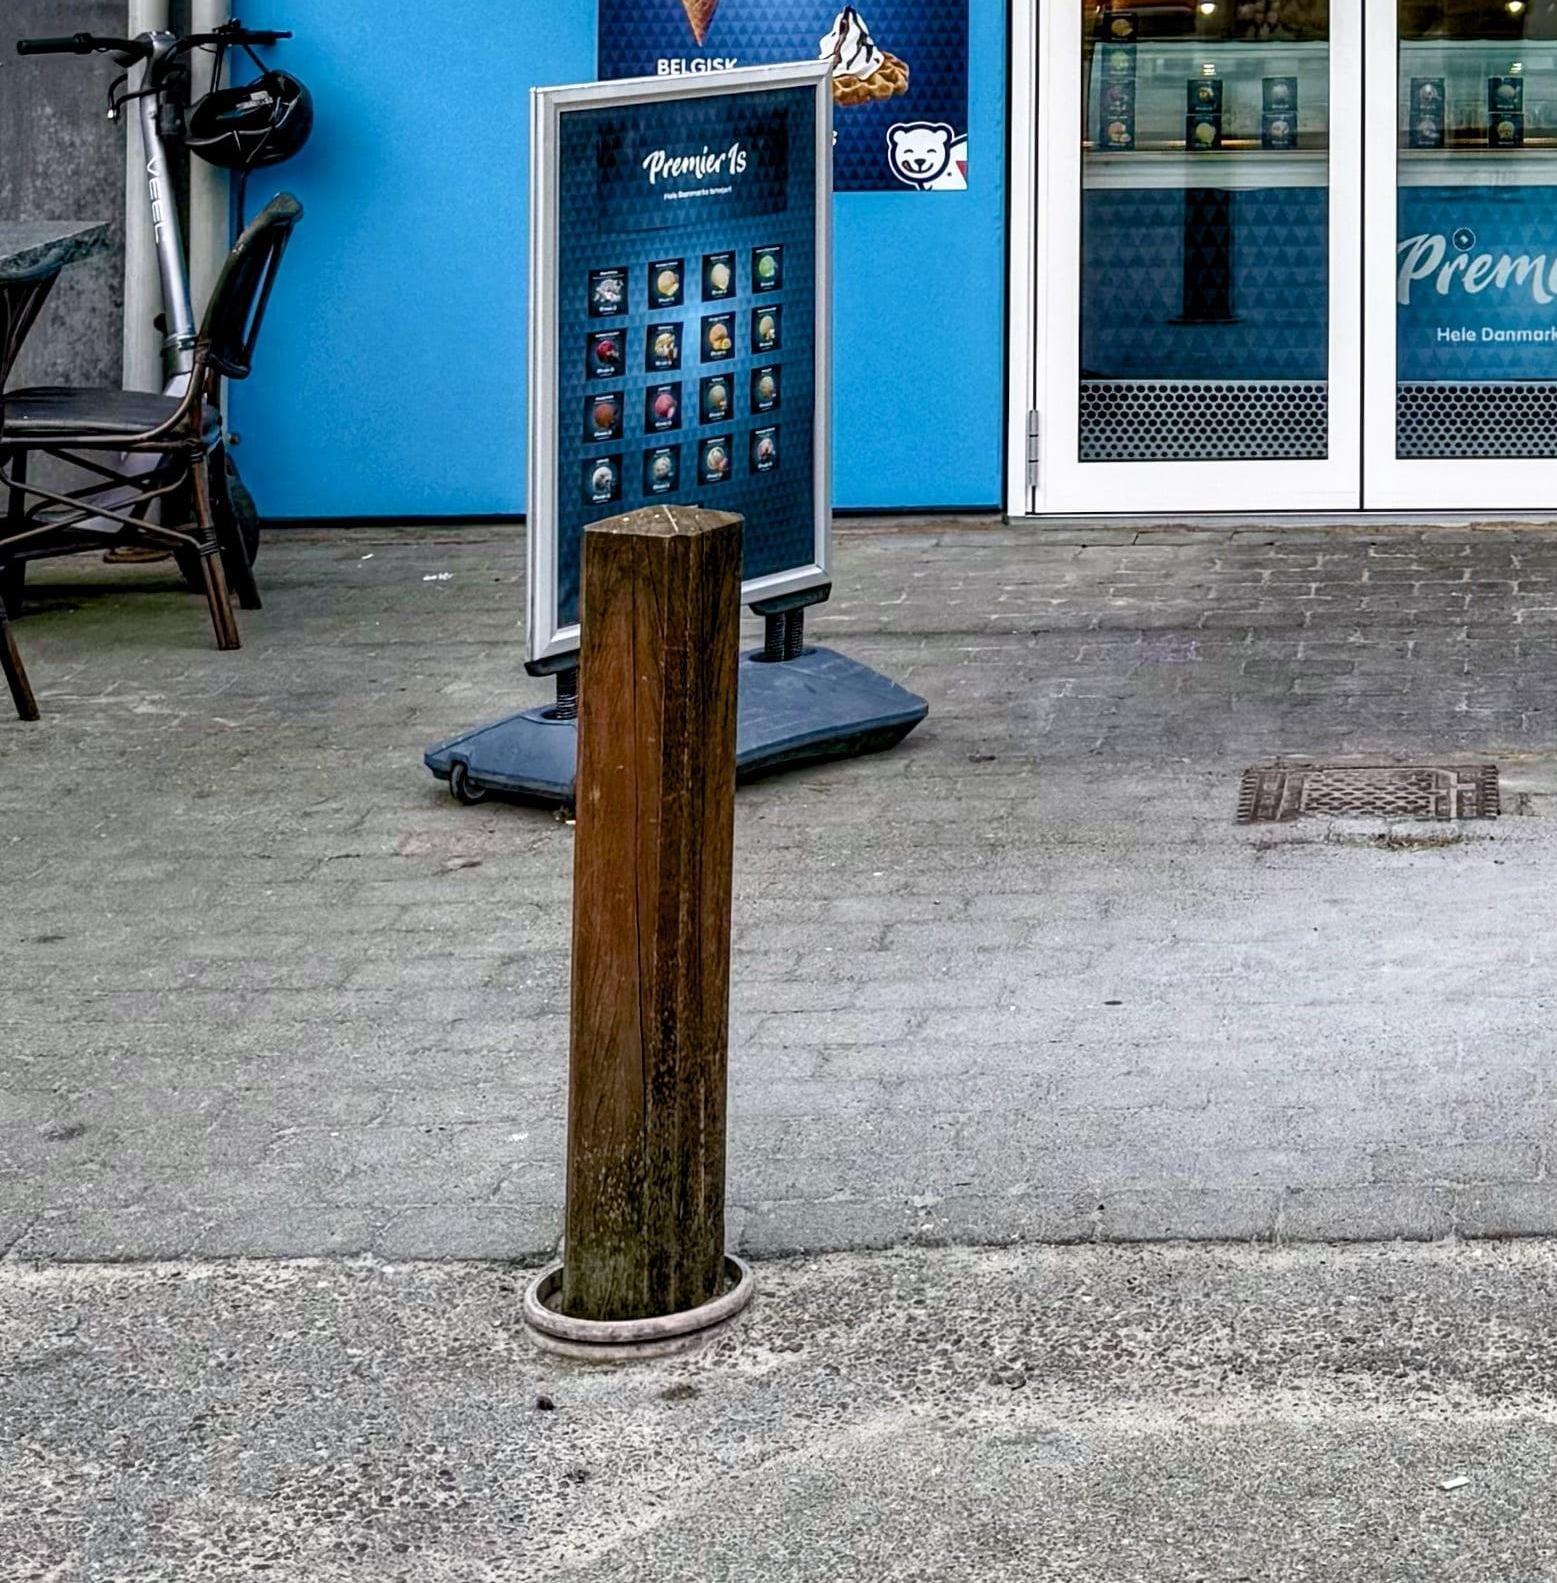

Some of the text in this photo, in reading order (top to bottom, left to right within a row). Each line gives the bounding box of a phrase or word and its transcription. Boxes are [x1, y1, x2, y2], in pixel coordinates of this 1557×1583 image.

[657, 58, 737, 75] BELGISK
[642, 145, 726, 185] Premier
[147, 158, 165, 244] VEEL
[1437, 327, 1476, 342] Hele
